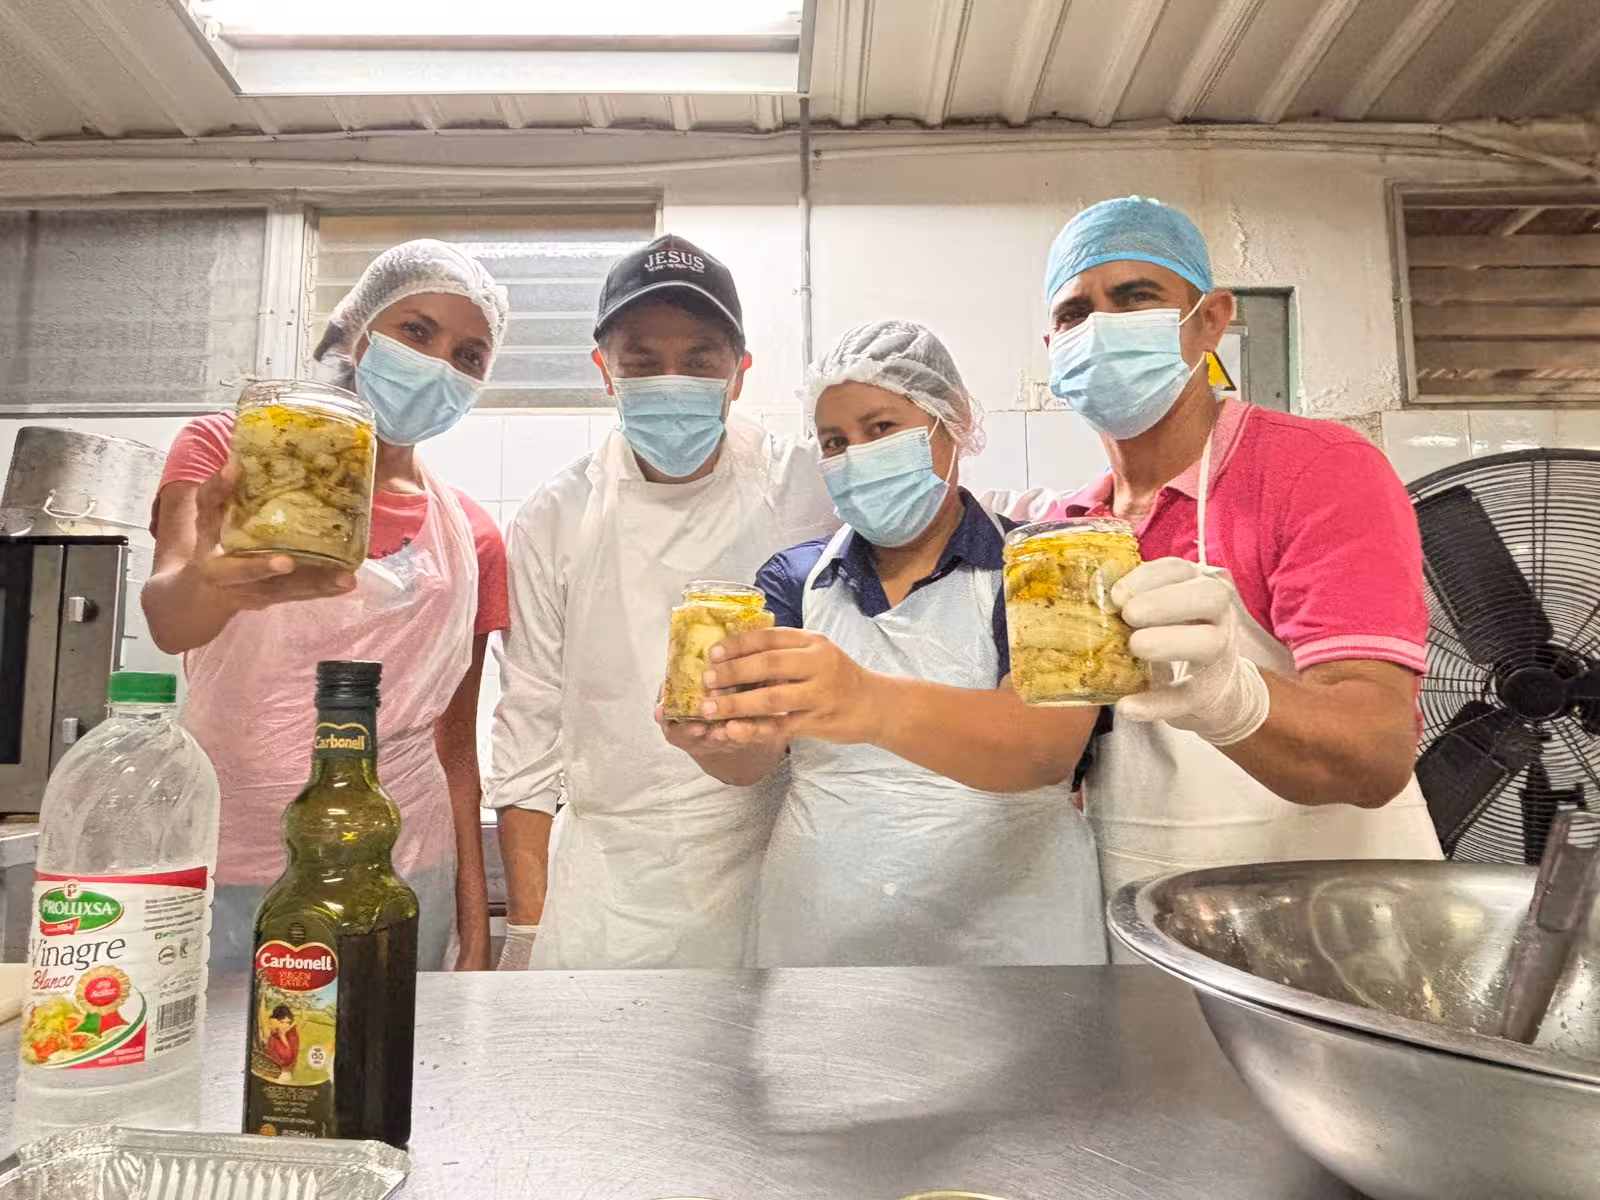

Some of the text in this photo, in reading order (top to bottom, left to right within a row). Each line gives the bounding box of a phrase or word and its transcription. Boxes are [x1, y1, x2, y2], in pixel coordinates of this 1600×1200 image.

[644, 250, 705, 270] JESUS
[42, 899, 114, 916] PROLUXSA
[31, 938, 126, 971] Vinagre
[260, 952, 333, 971] Carbonell
[32, 969, 75, 990] Blanco
